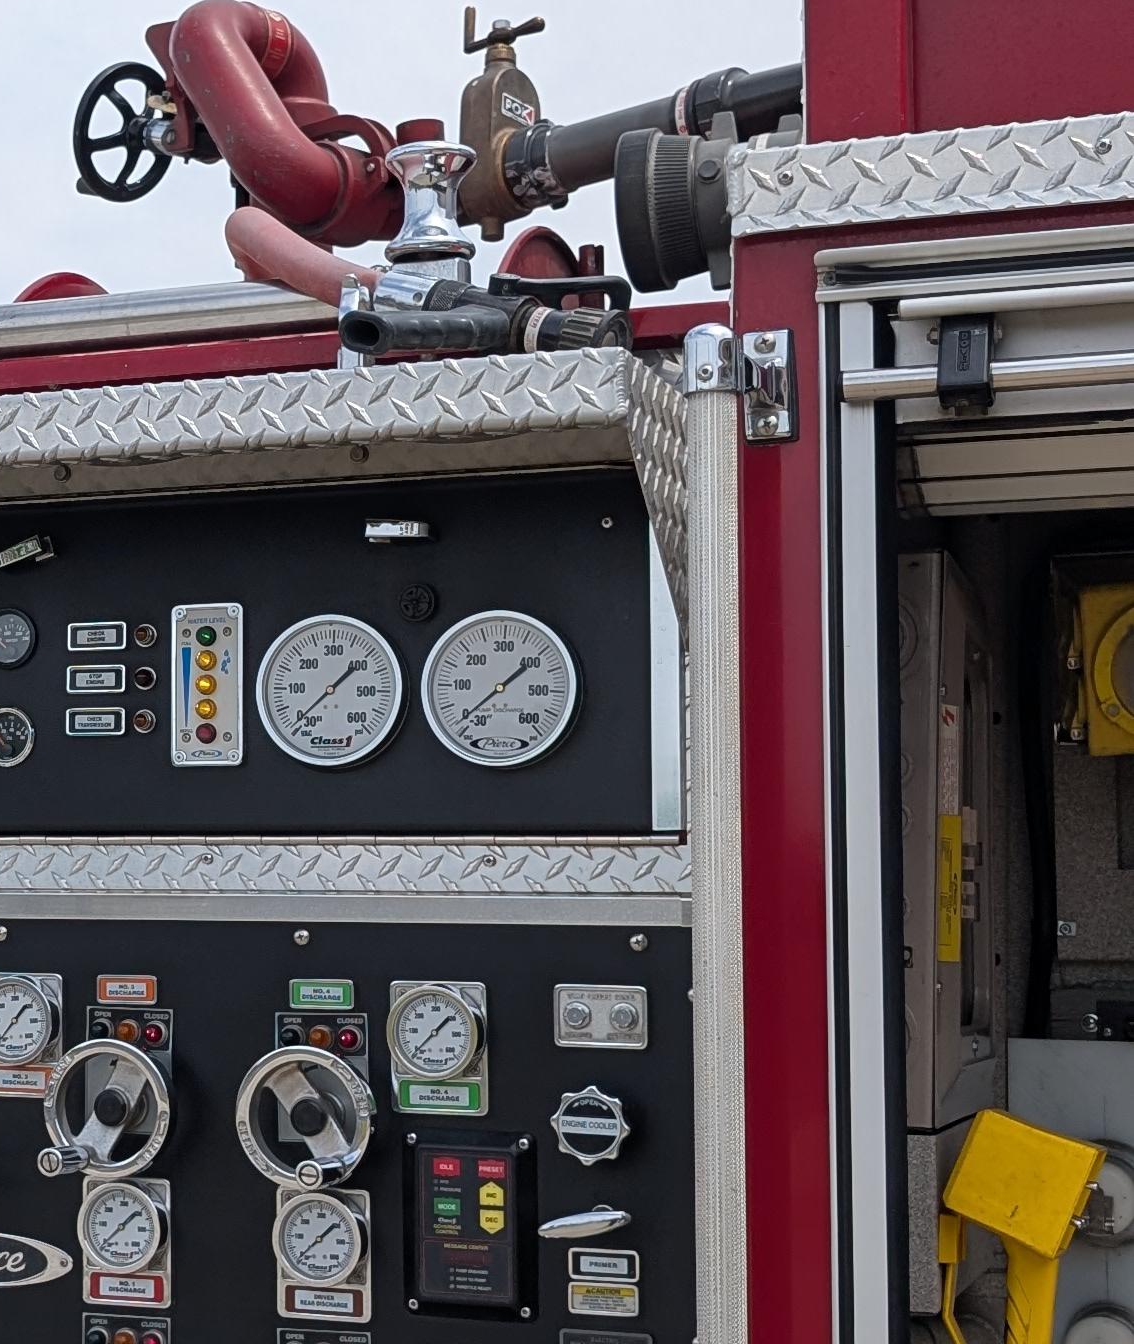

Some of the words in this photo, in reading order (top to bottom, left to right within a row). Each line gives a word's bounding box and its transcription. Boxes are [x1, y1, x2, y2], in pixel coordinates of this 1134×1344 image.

[505, 97, 531, 124] POK
[323, 644, 344, 656] 300
[493, 640, 514, 652] 300
[299, 658, 319, 670] 200
[347, 659, 368, 671] 400
[465, 654, 487, 666] 200
[519, 657, 541, 668] 400
[288, 682, 305, 694] 100
[453, 679, 472, 690] 100
[528, 684, 549, 696] 500
[356, 685, 376, 697] 500
[296, 709, 304, 721] 0
[346, 711, 367, 723] 600
[462, 708, 469, 720] 0
[518, 712, 539, 724] 600
[482, 737, 516, 749] Pierce
[336, 1017, 364, 1025] CLOSED
[2, 1078, 38, 1086] DISCHARGE
[579, 1098, 599, 1106] OPEN
[561, 1120, 588, 1129] ENGINE
[588, 1121, 617, 1130] COOLER
[478, 1165, 504, 1173] PRESET
[588, 1261, 618, 1269] PRIMER
[108, 1286, 146, 1294] DISCHARGE
[316, 1300, 348, 1309] DISCHARGE
